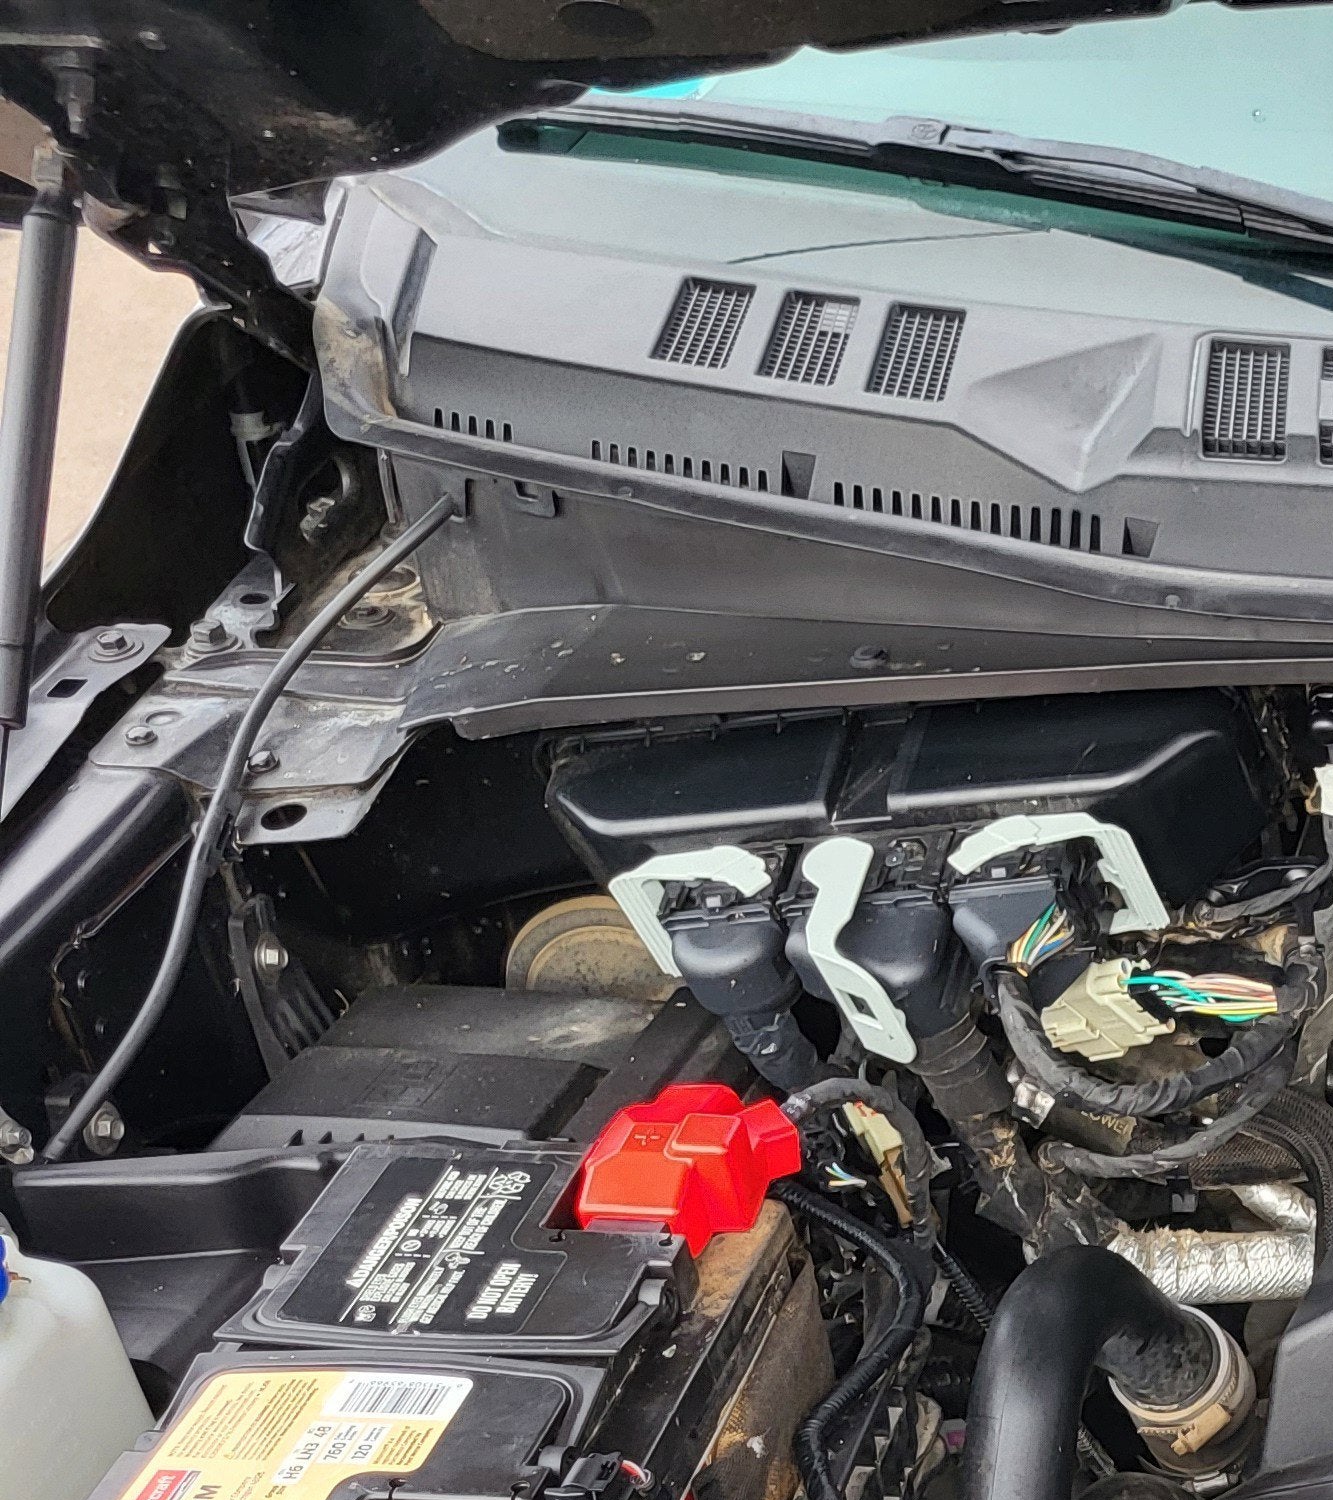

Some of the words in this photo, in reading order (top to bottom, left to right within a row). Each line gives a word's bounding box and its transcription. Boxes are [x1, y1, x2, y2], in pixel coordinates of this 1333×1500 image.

[322, 1441, 348, 1460] 760
[349, 1443, 374, 1460] 120
[281, 1464, 305, 1479] H6
[295, 1442, 320, 1460] LN3
